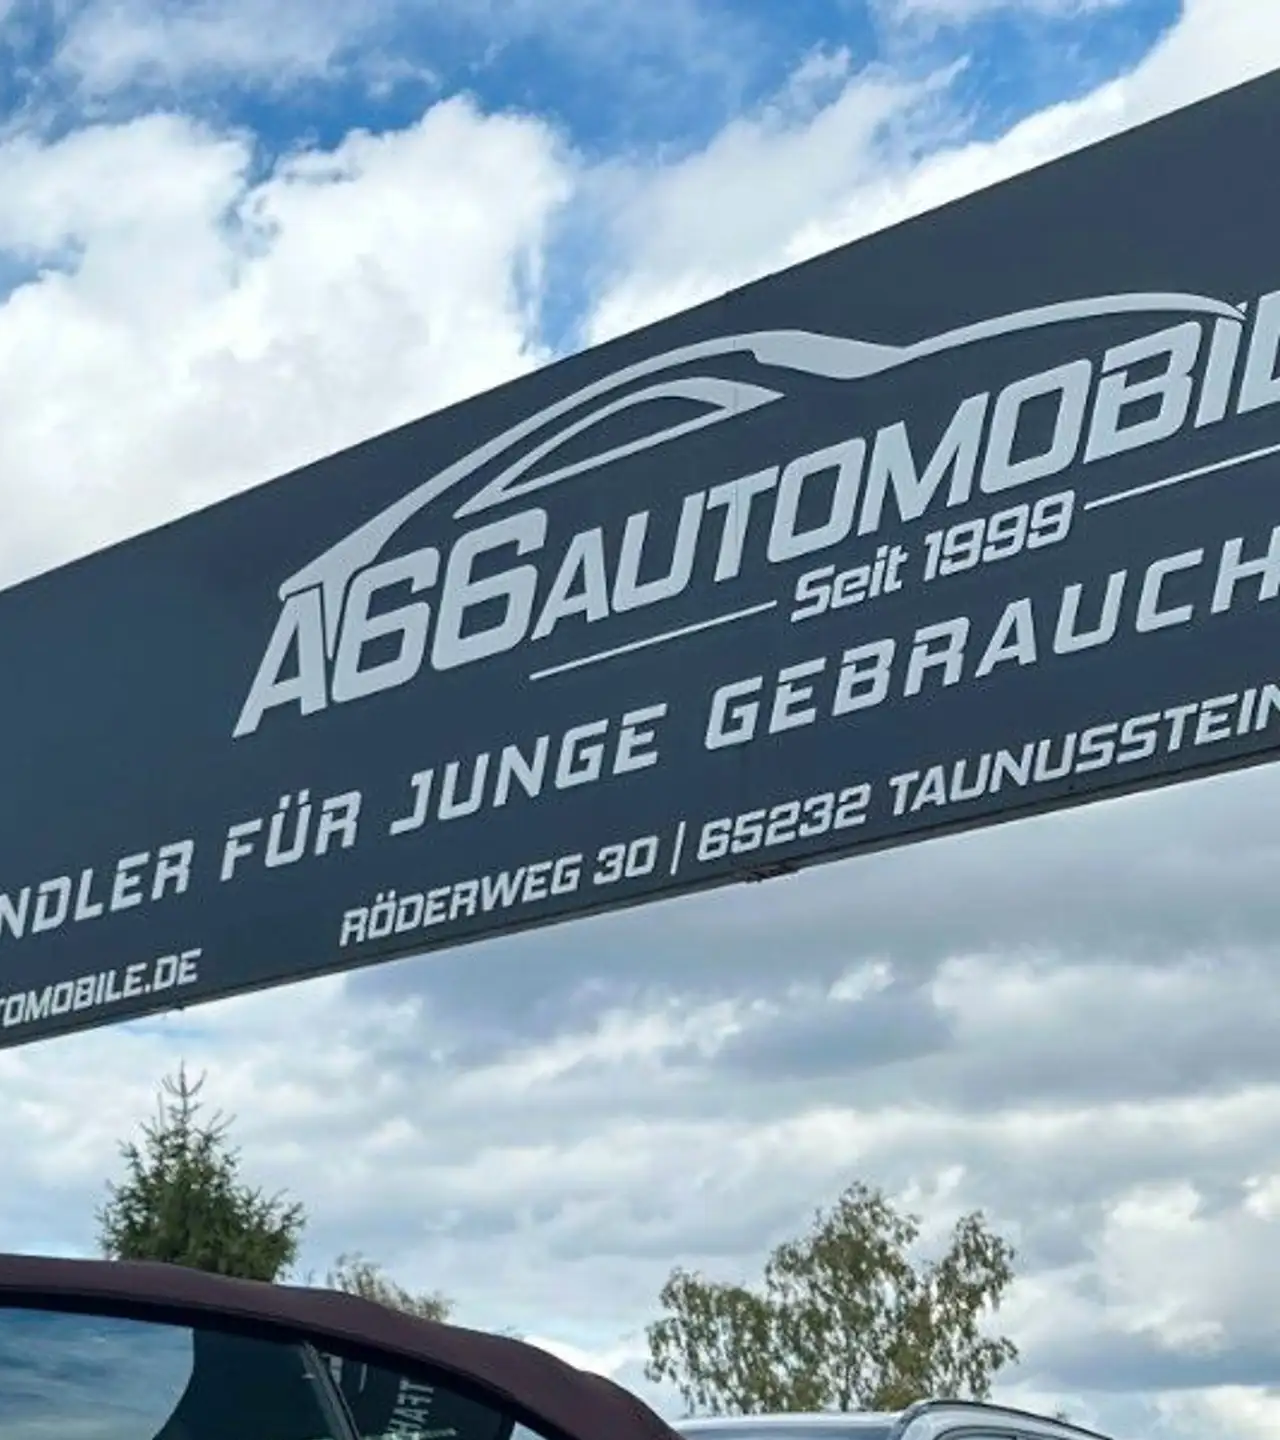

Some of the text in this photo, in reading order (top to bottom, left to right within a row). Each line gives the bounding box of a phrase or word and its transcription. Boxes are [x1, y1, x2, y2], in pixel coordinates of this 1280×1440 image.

[790, 489, 1076, 623] Seit 1999
[221, 788, 362, 882] FÜR
[389, 702, 667, 836] JUNGE
[339, 854, 582, 947] RÖDERWEG
[593, 835, 659, 885] 30
[696, 783, 871, 861] 65232
